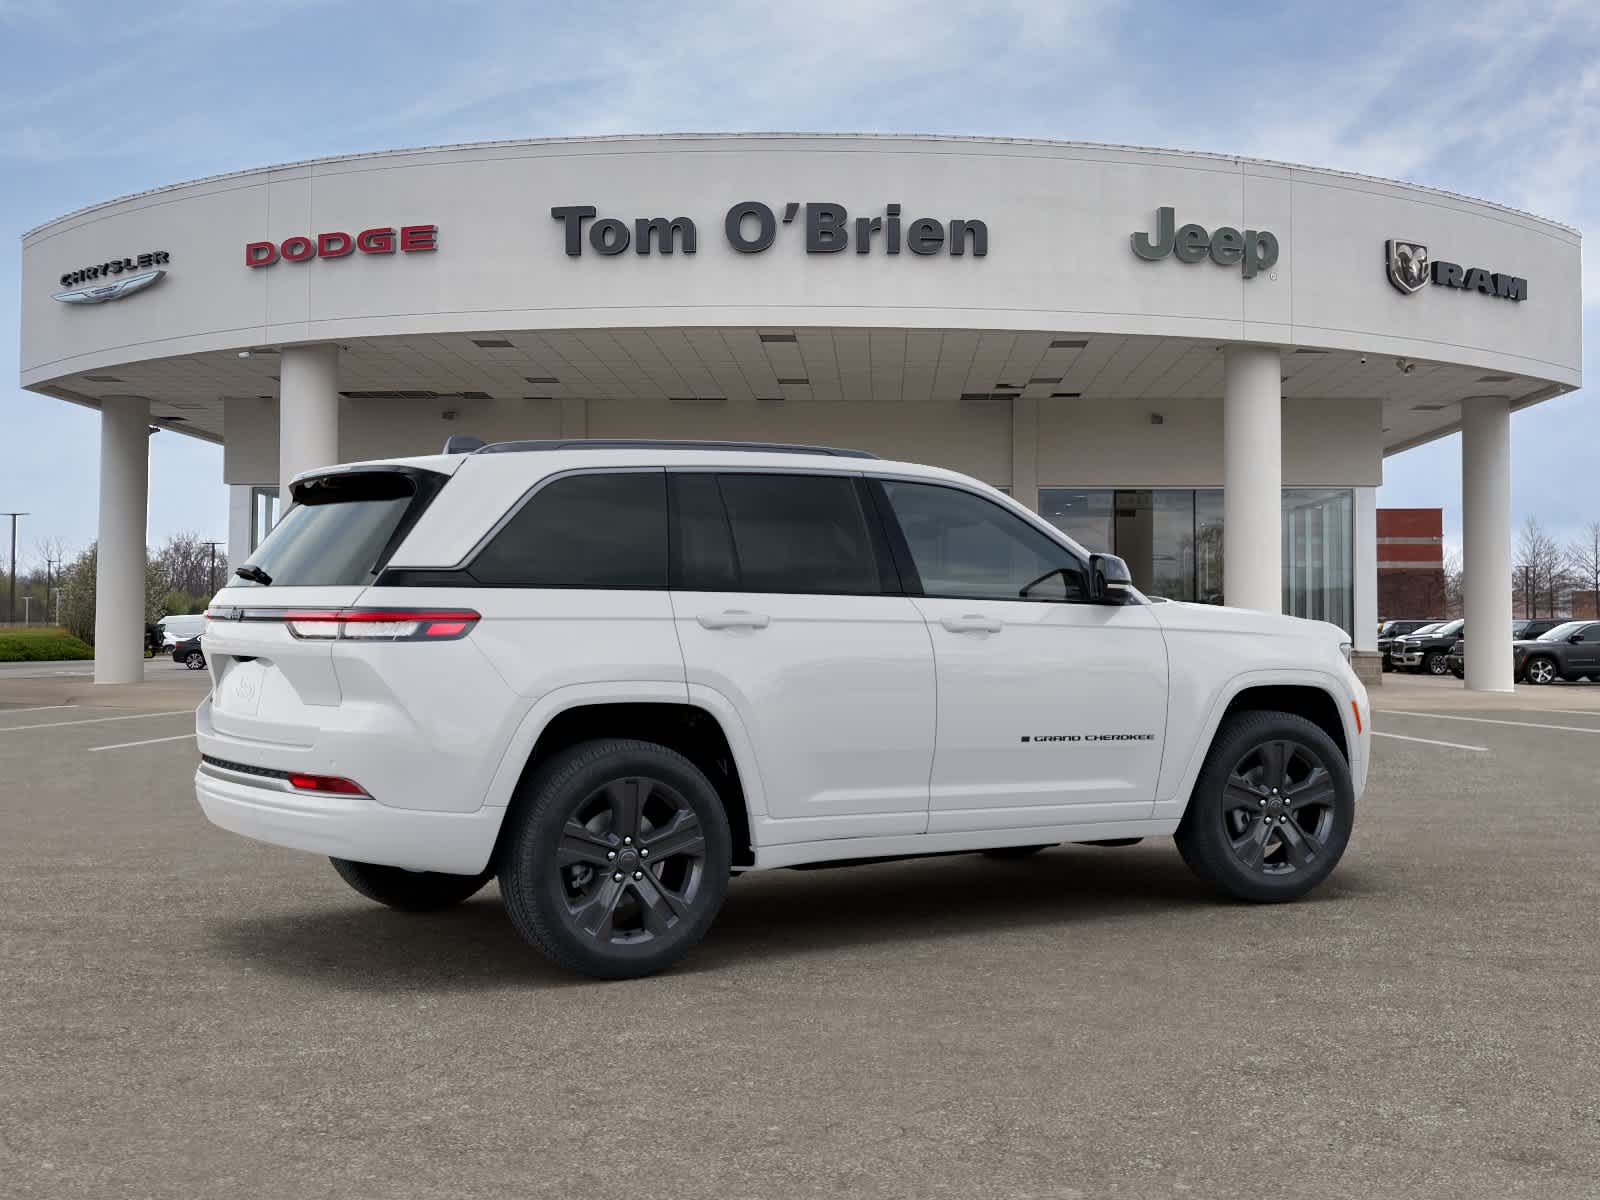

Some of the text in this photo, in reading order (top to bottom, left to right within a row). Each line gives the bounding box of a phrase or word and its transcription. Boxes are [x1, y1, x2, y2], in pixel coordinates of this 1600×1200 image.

[245, 223, 438, 268] DODGE
[550, 200, 989, 257] Tom O'Brien
[1130, 206, 1280, 280] Jeep
[60, 249, 170, 287] CHRYSLER
[1430, 260, 1528, 302] RAM
